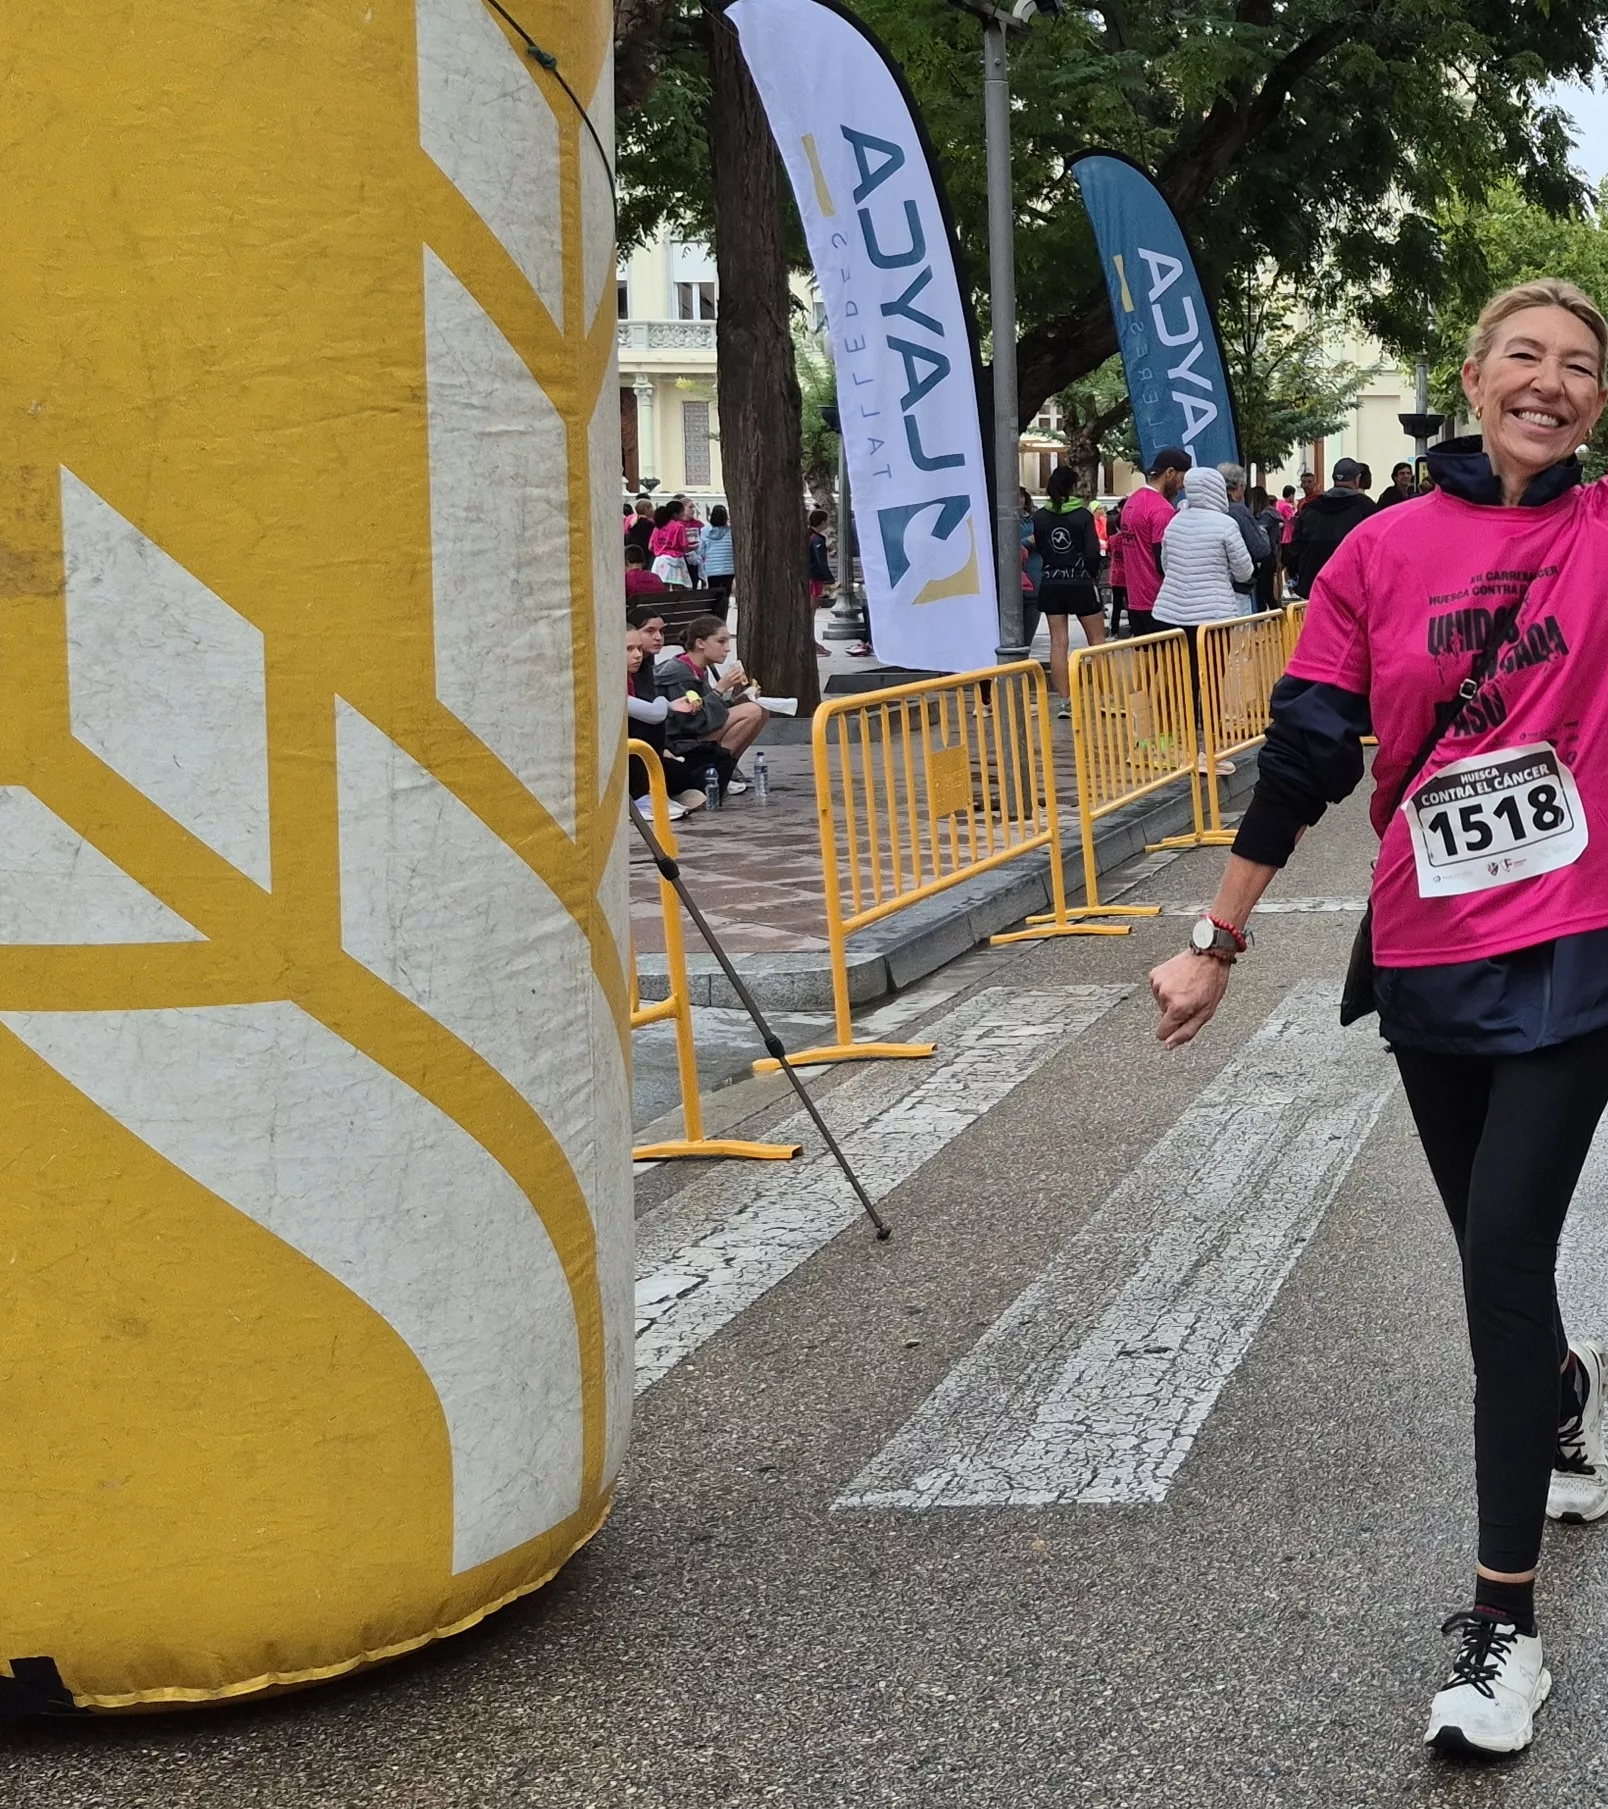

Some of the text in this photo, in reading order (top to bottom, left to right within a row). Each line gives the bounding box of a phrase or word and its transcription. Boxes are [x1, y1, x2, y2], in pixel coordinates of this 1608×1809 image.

[1421, 764, 1550, 806] CONTRA EL CÁNCER
[1460, 767, 1500, 784] HUESCA
[1429, 784, 1565, 857] 1518
